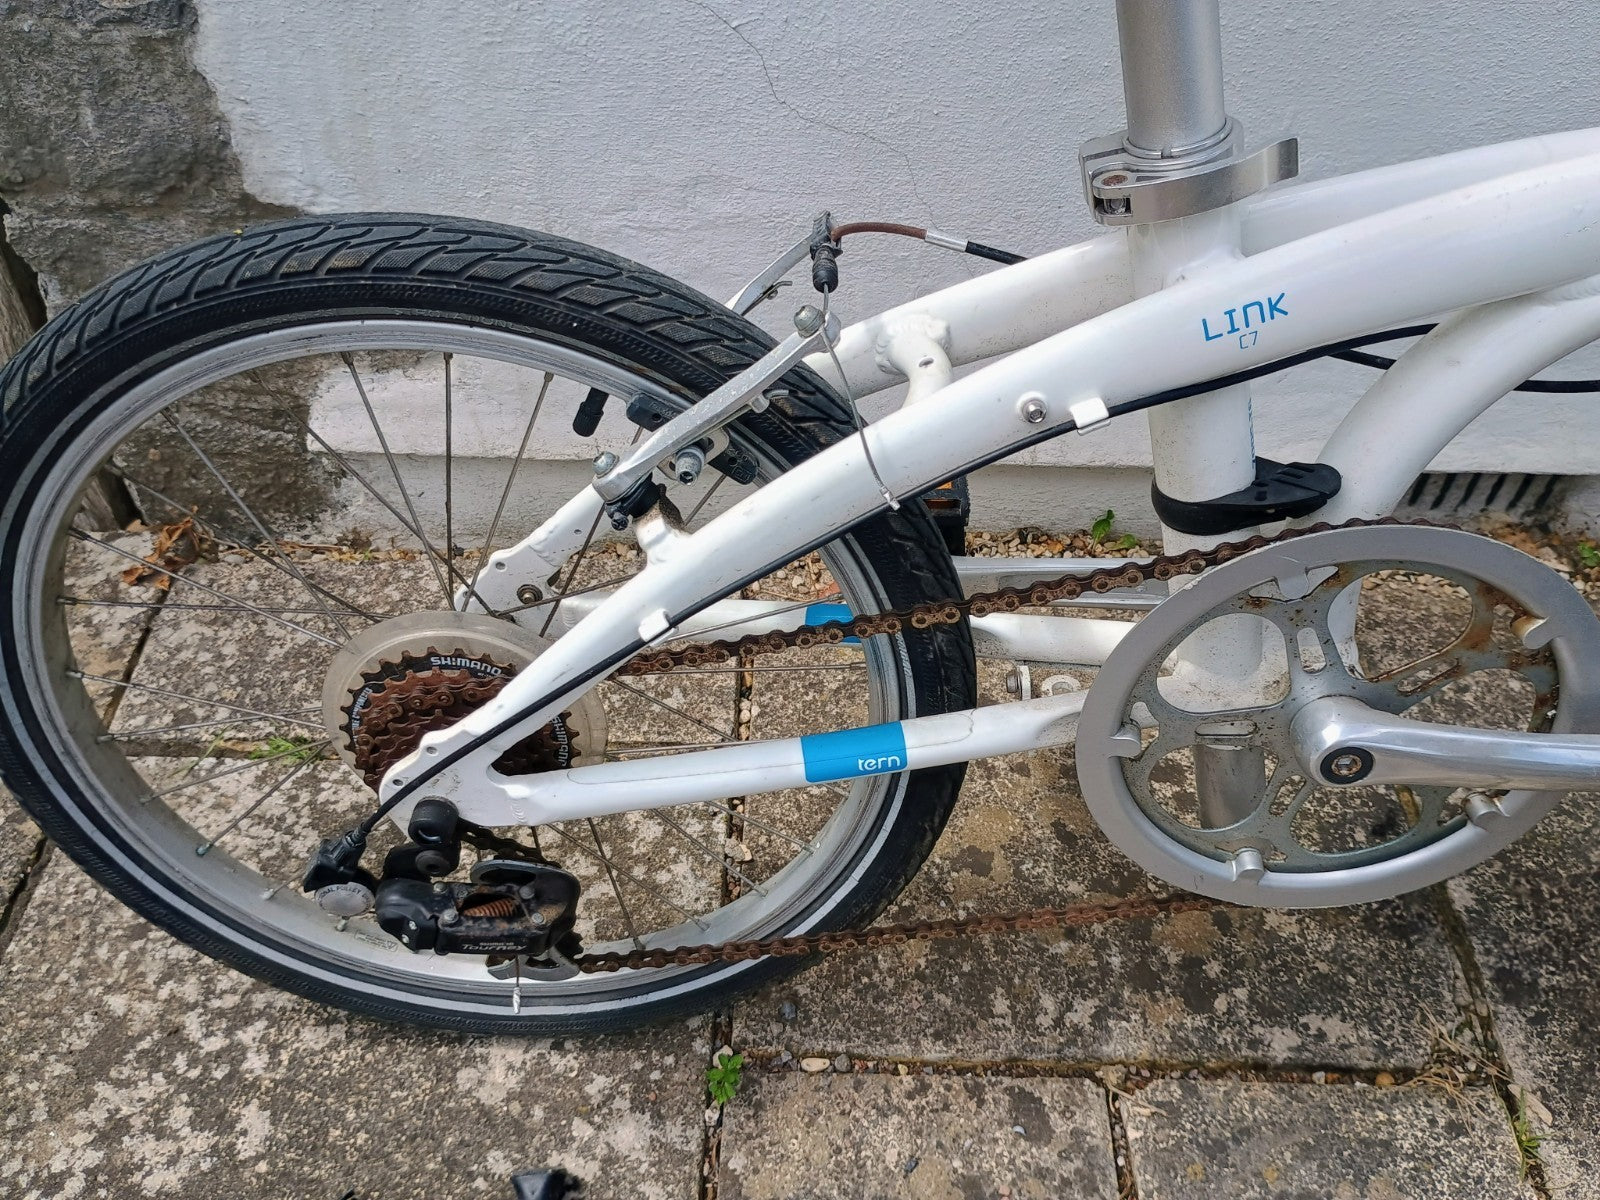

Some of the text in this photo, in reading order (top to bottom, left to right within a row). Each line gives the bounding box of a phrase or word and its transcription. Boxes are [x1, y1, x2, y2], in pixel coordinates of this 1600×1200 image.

[1202, 293, 1289, 342] LINK
[1239, 331, 1258, 350] C7
[430, 656, 502, 676] SHIMANO
[858, 755, 901, 771] tern
